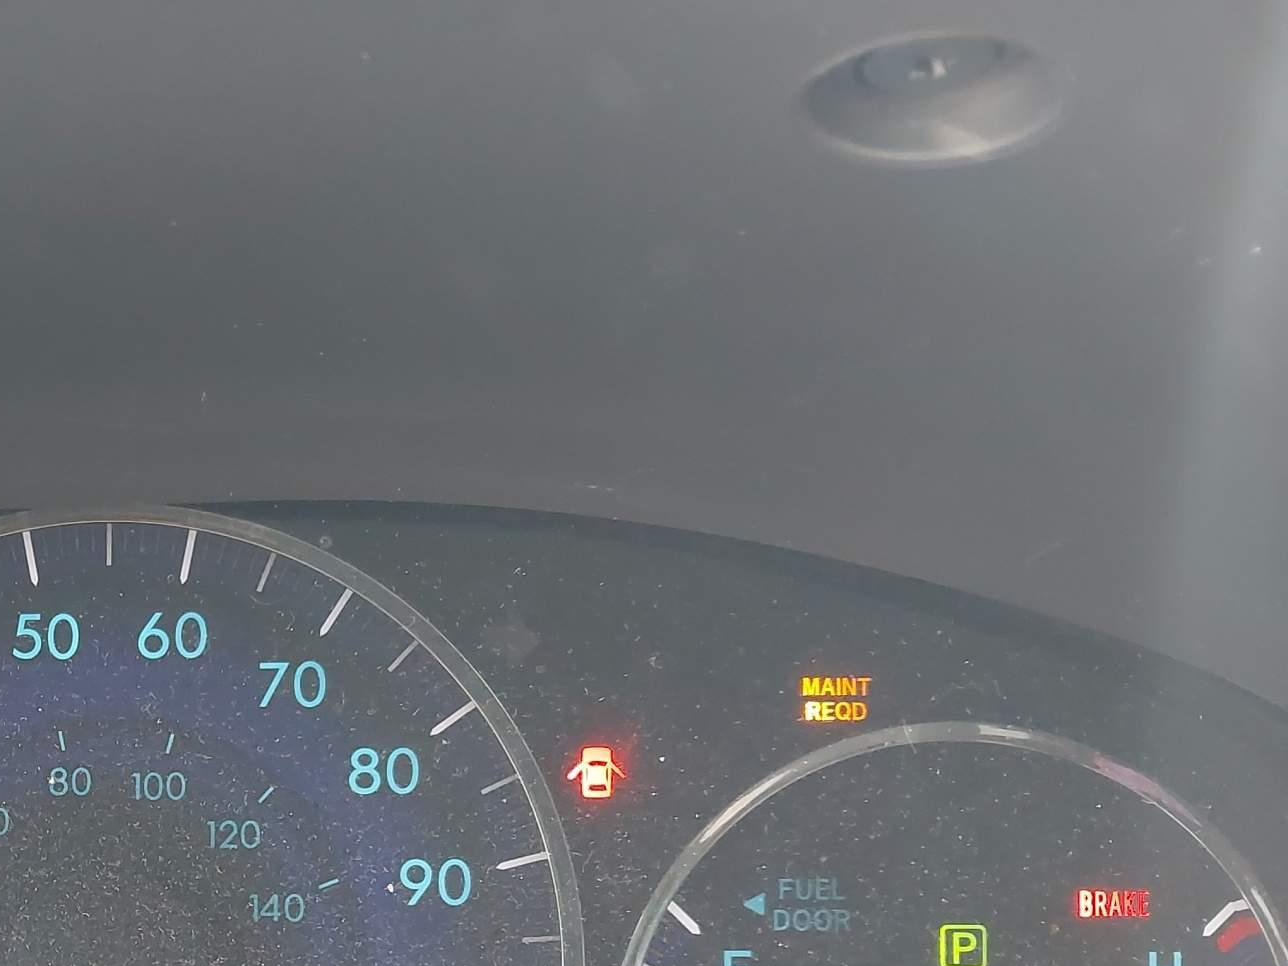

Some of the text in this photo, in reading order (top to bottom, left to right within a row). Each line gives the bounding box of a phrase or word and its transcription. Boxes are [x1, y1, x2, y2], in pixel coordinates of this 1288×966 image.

[12, 611, 81, 661] 50
[137, 611, 208, 661] 60
[258, 660, 327, 709] 70
[801, 677, 871, 698] MAINT
[804, 700, 867, 721] REQD
[49, 767, 92, 797] 80
[133, 771, 186, 801] 100
[348, 746, 420, 796] 80
[208, 819, 261, 849] 120
[399, 858, 472, 906] 90
[777, 878, 846, 901] FUEL
[250, 892, 305, 923] 140
[1077, 890, 1149, 918] BRAKE
[772, 908, 851, 933] DOOR
[952, 931, 976, 964] P
